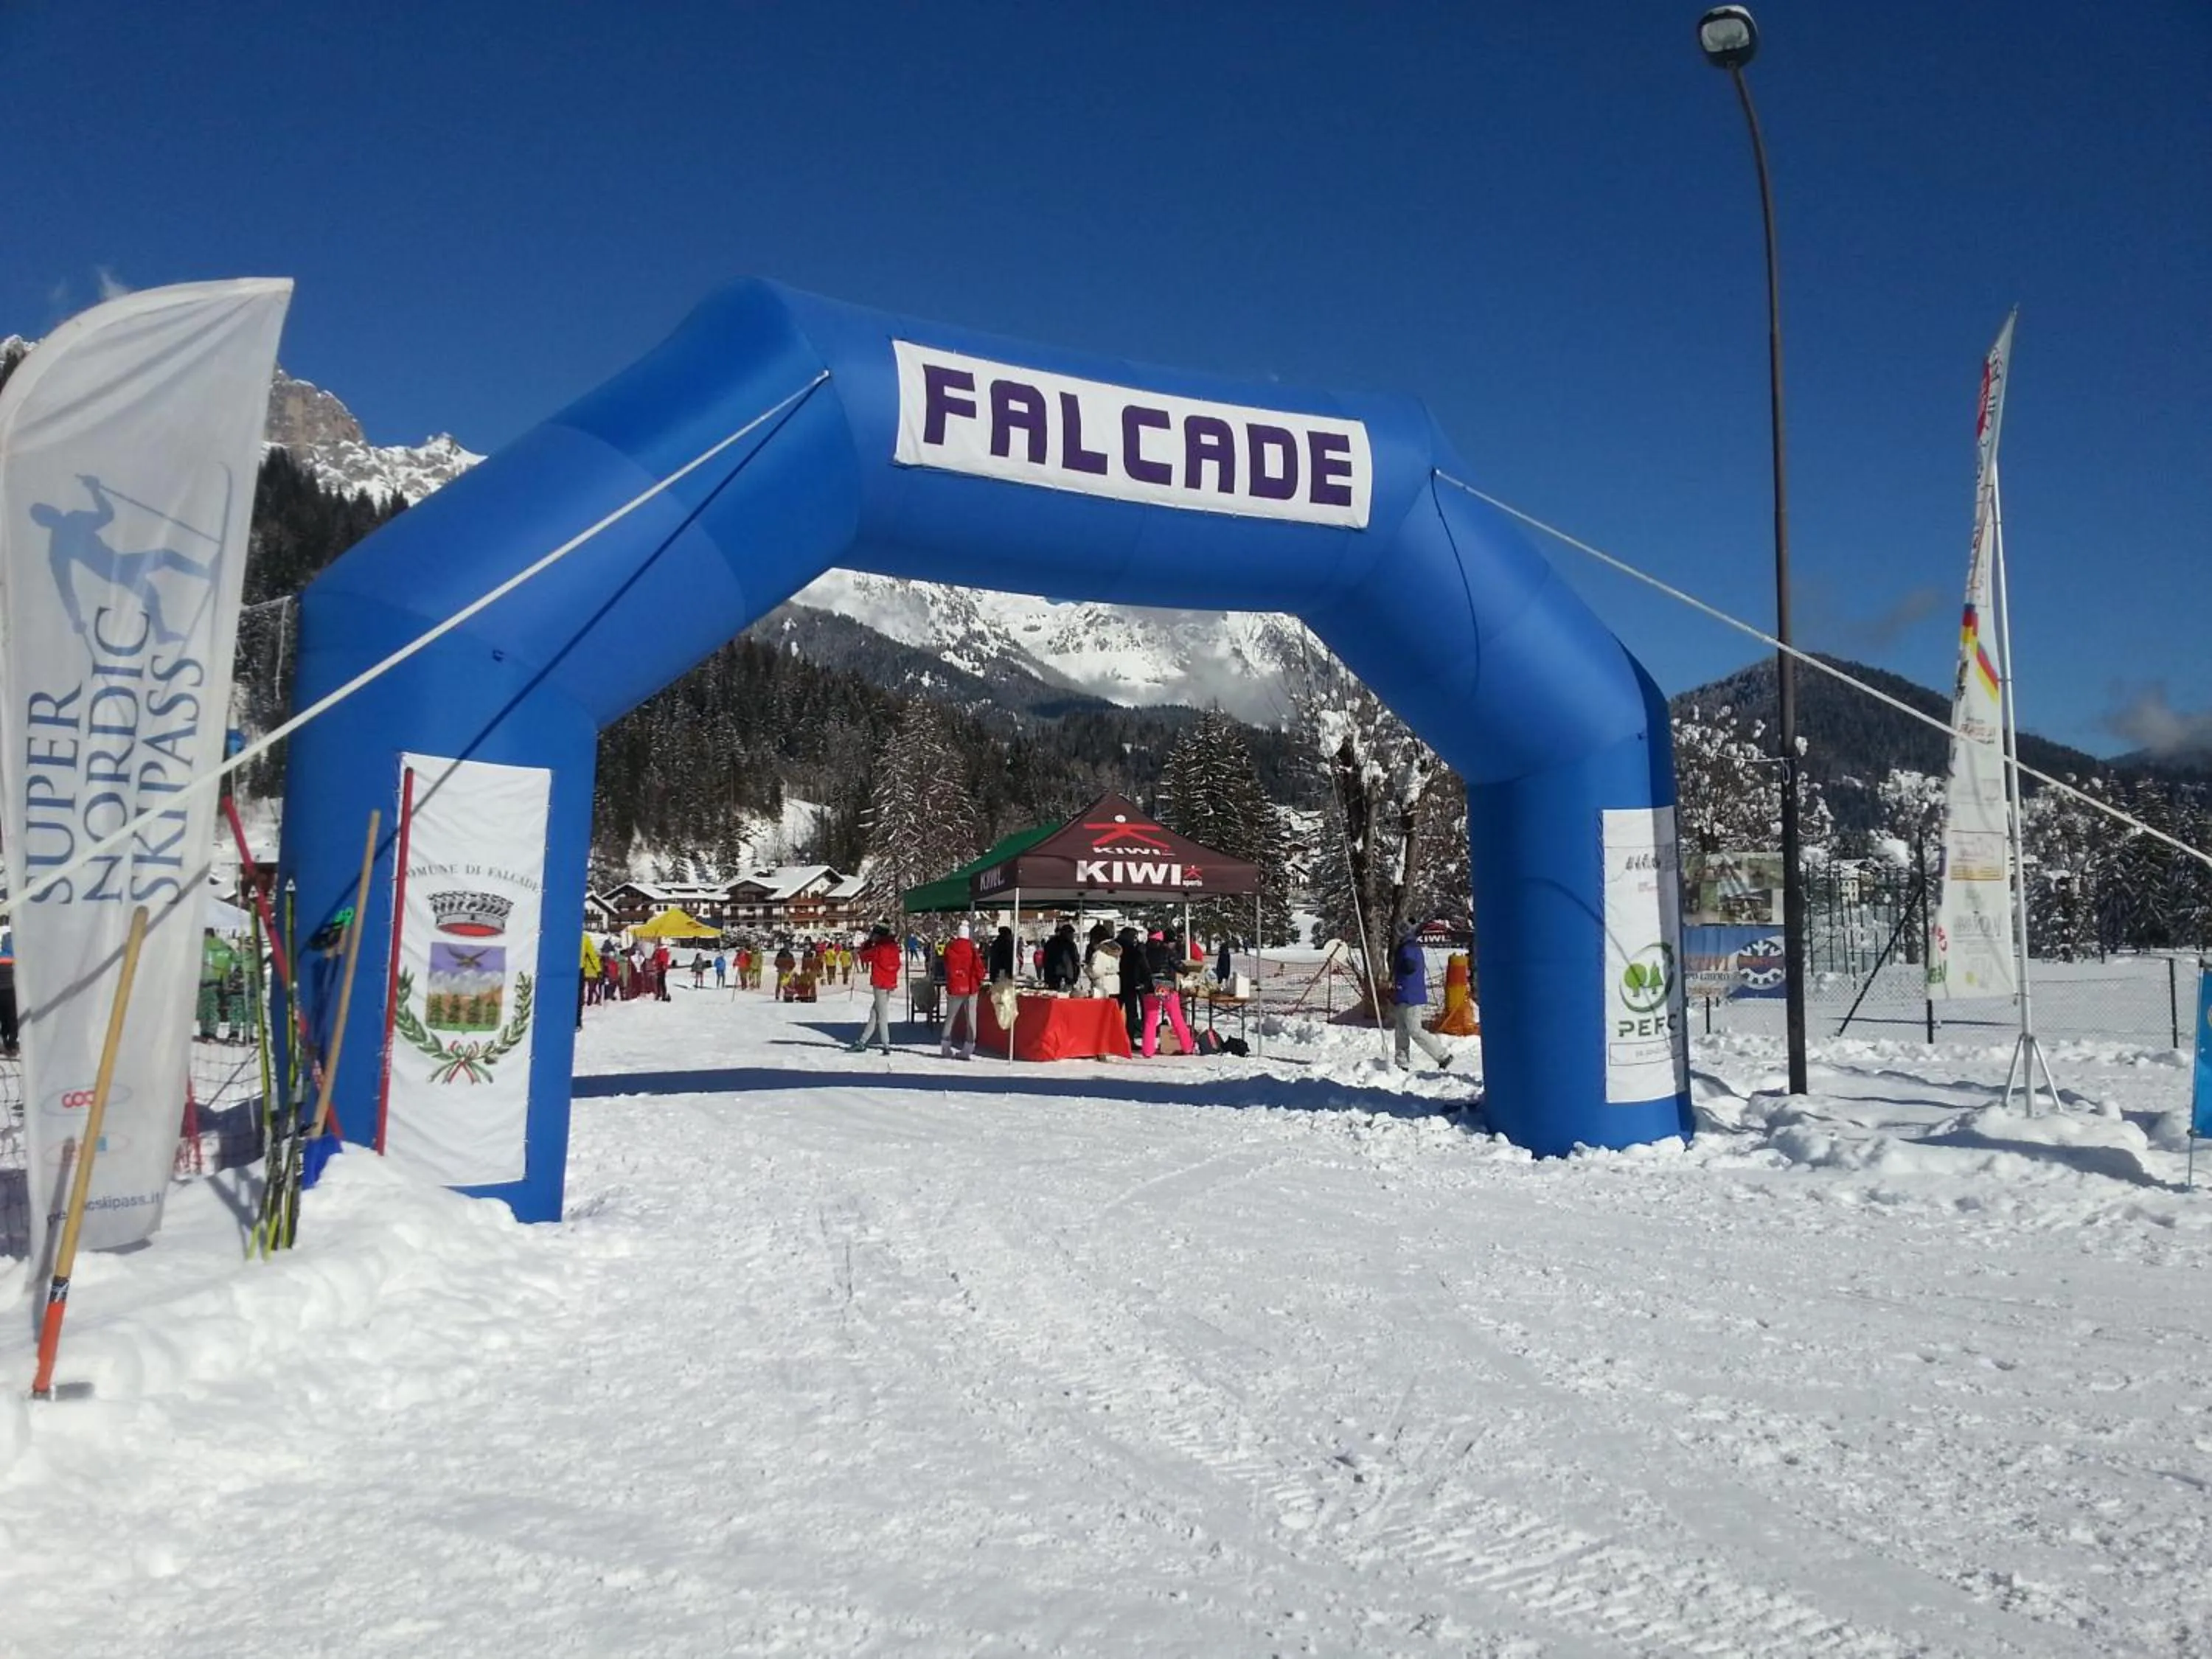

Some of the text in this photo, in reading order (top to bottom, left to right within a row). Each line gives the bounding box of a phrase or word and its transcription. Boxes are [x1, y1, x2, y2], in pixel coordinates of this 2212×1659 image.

[922, 364, 1352, 507] FALCADE
[82, 606, 150, 905] NORDIC
[24, 680, 83, 905] SUPER
[130, 655, 204, 905] SKIPASS
[1092, 847, 1161, 856] KIWI
[406, 863, 459, 878] OMUNE
[465, 863, 481, 875] DI
[1076, 860, 1182, 886] KIWI
[1618, 1013, 1677, 1037] PEFC
[62, 1091, 96, 1108] coo
